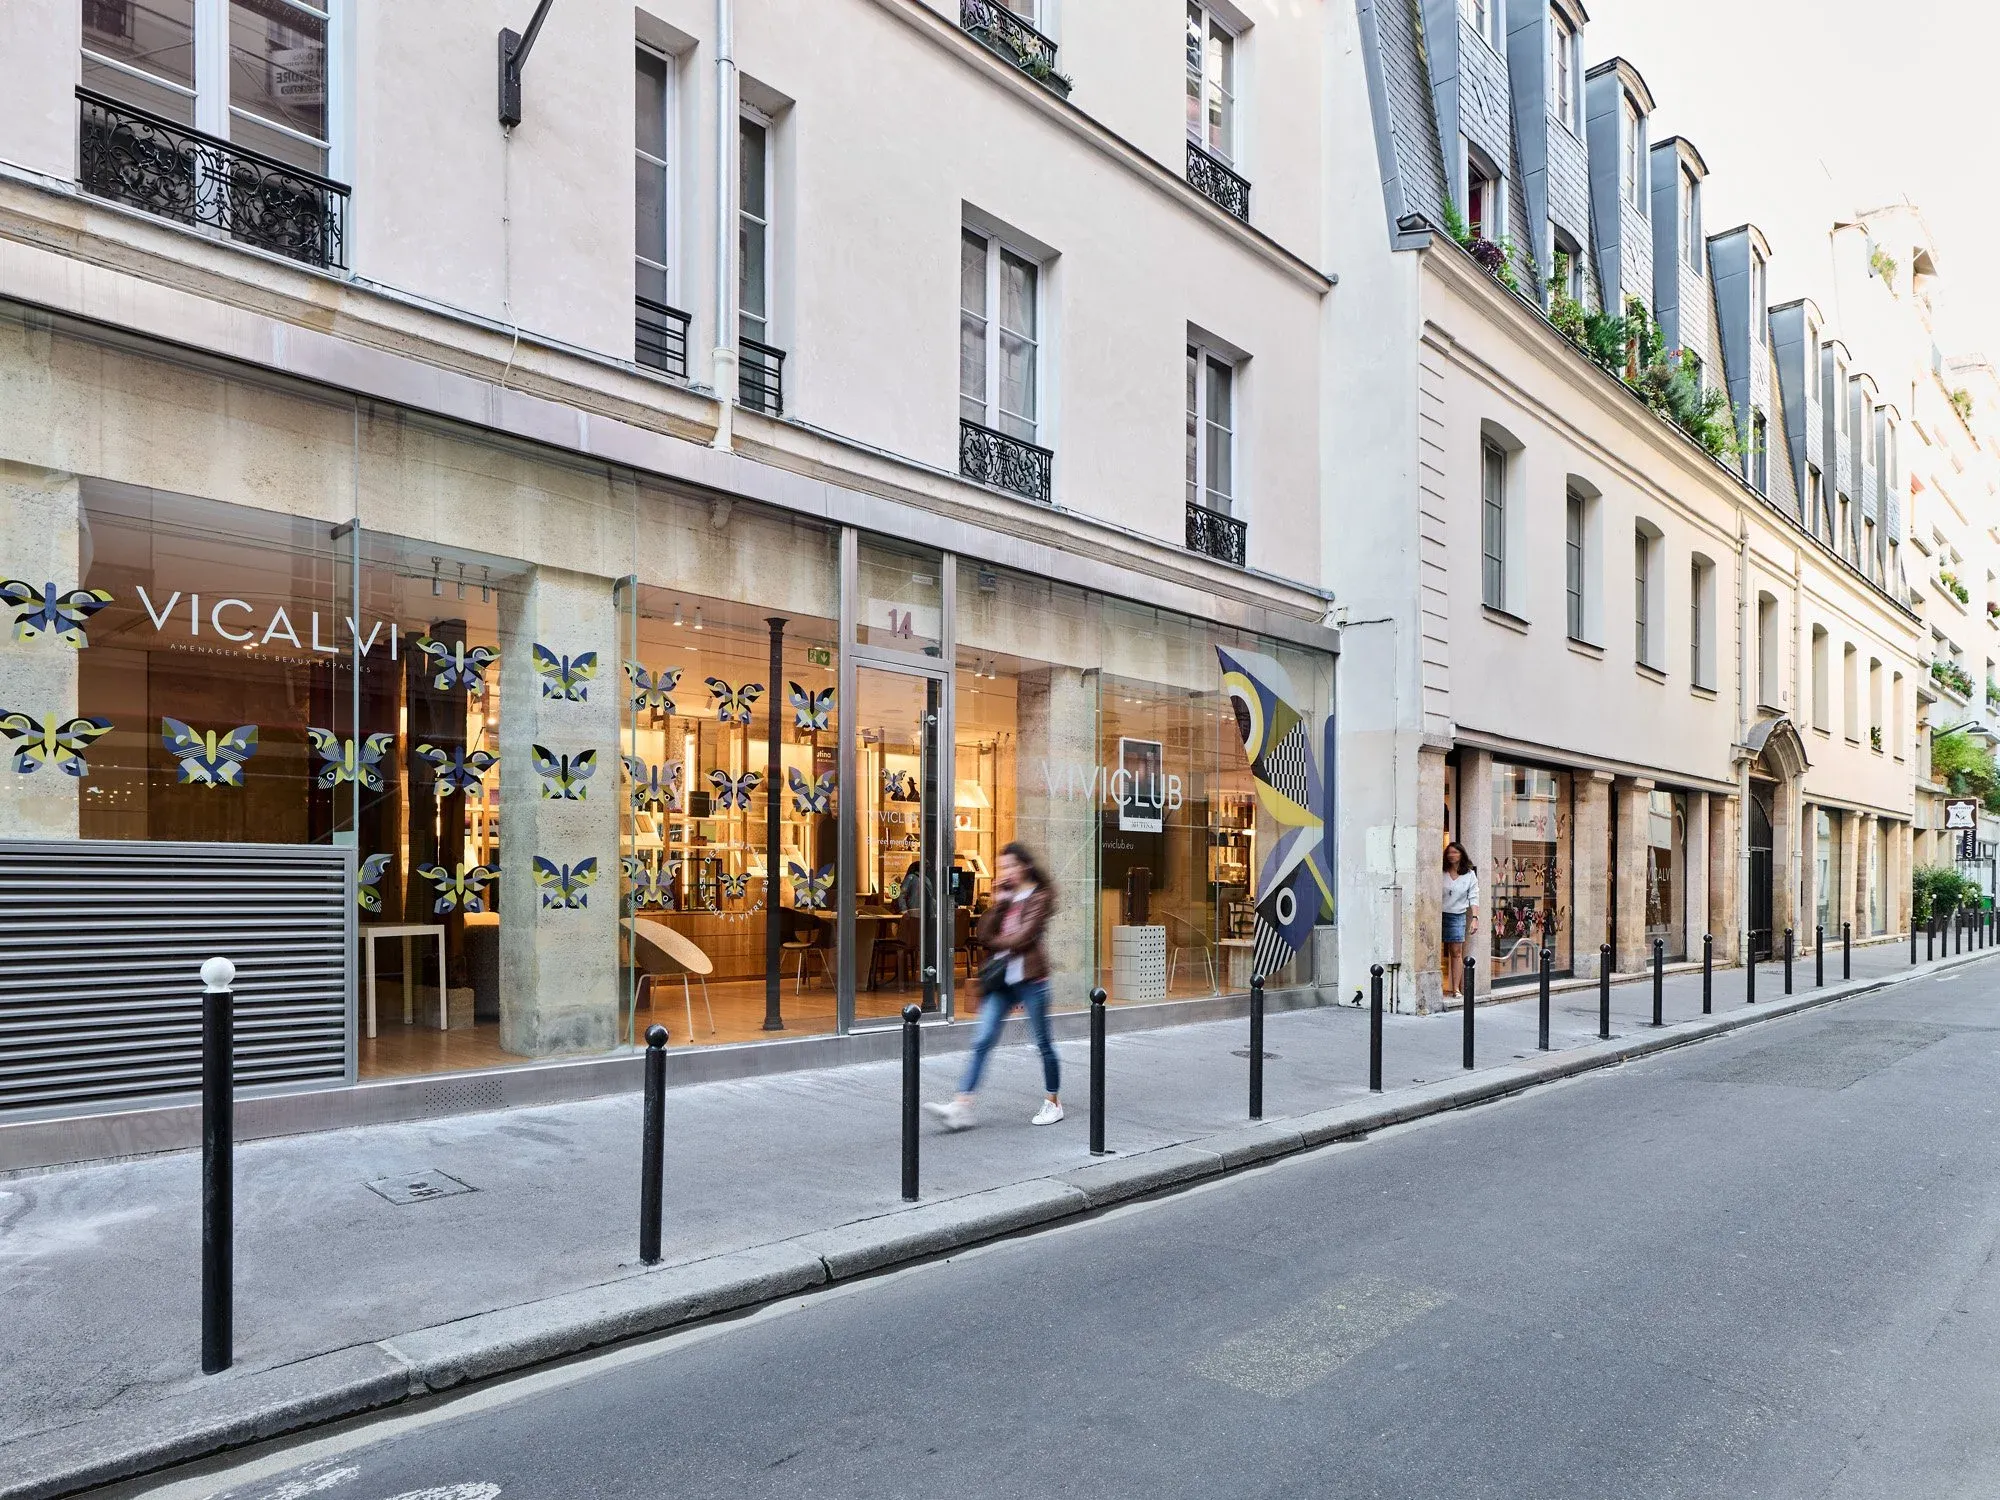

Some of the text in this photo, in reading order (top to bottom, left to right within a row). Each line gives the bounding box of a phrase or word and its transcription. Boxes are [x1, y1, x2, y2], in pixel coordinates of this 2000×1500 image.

[136, 585, 397, 660] VICALVI
[888, 608, 913, 639] 14
[170, 643, 371, 673] AMENAGER LES BEAUX ESPACES
[1042, 759, 1183, 810] VIVICLUB
[1102, 838, 1134, 850] viviclub.eu
[891, 885, 897, 896] 15
[739, 899, 764, 921] VIVRE
